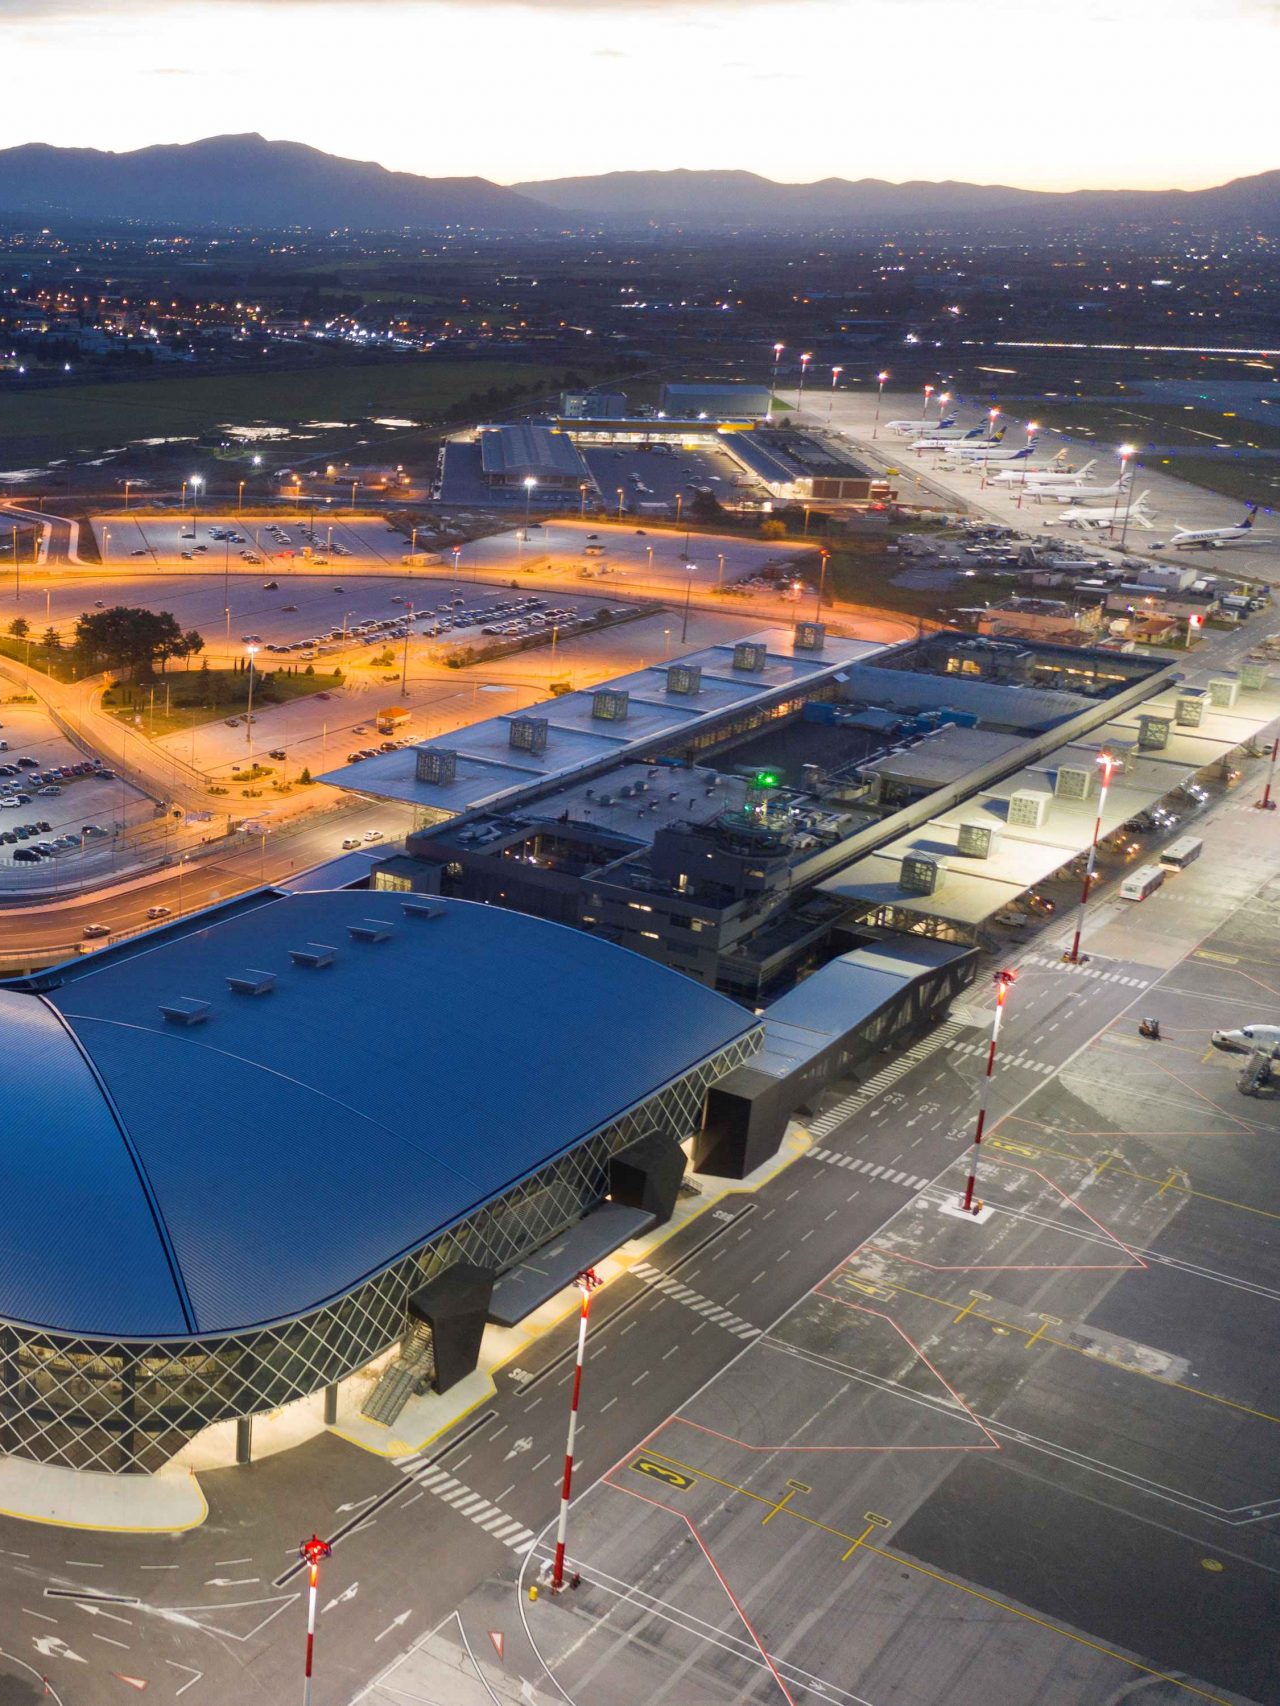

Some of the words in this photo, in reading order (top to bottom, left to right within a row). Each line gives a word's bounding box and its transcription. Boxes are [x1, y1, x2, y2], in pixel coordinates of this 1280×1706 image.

[918, 1104, 938, 1114] 30
[947, 1128, 968, 1139] 30
[993, 1141, 1032, 1156] 5
[844, 1279, 887, 1295] 4
[640, 1463, 686, 1485] 3
